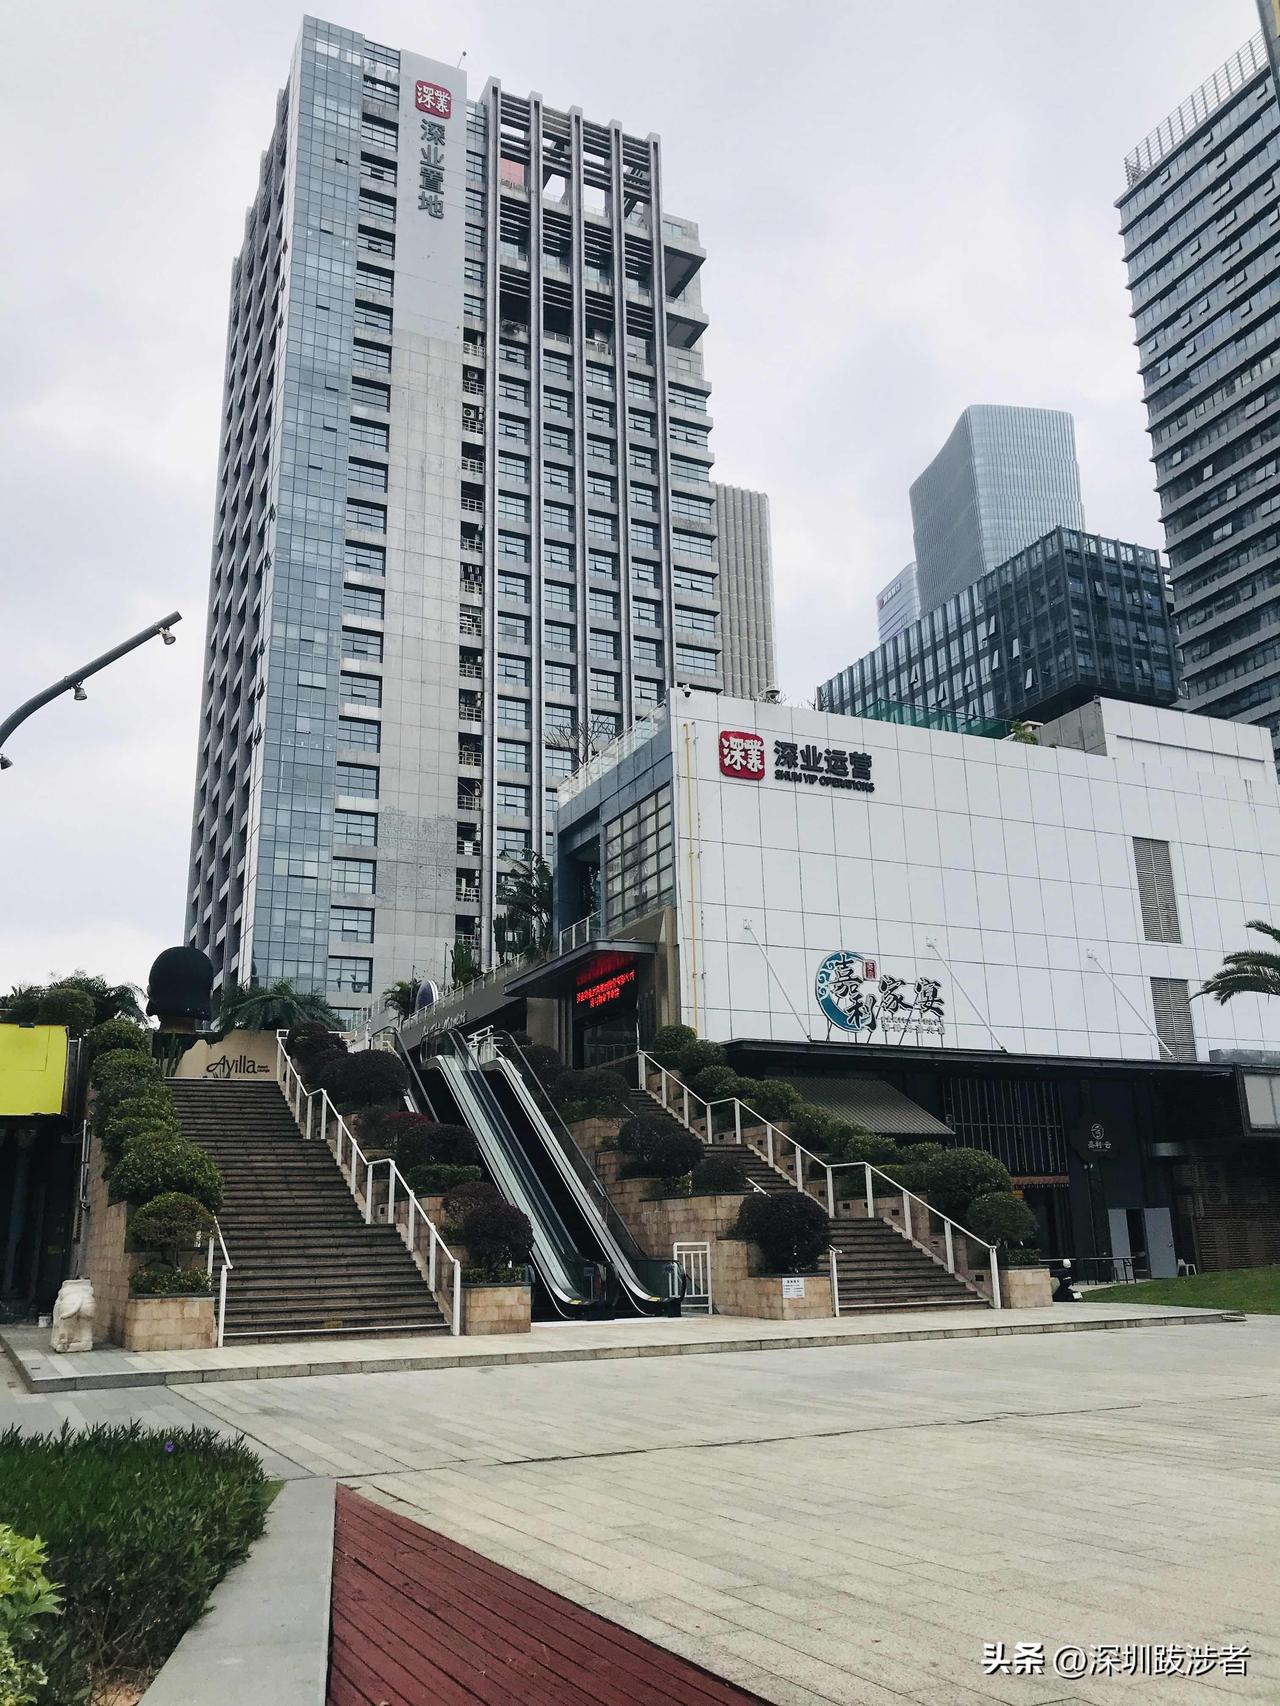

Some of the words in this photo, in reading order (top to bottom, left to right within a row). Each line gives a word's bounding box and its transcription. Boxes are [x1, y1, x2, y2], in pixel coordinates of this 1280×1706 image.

[418, 118, 445, 220] 深业置地
[774, 740, 873, 781] 深业运营
[774, 769, 803, 783] SHUM
[803, 773, 819, 785] YIP
[819, 775, 875, 793] OPERATIONS
